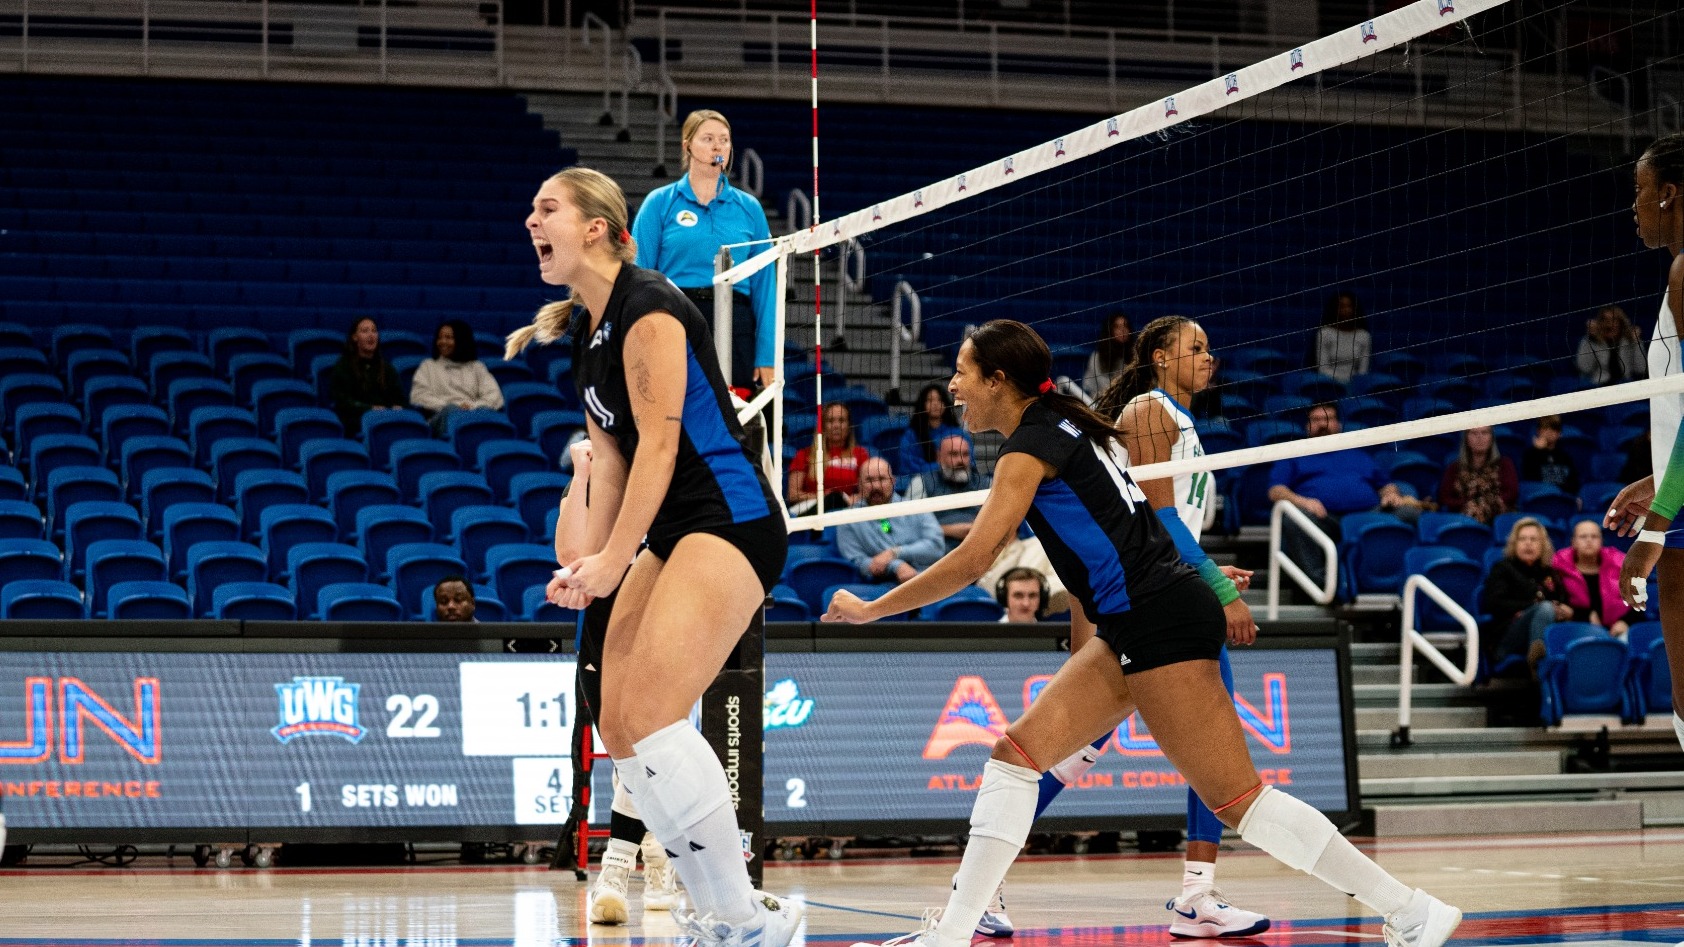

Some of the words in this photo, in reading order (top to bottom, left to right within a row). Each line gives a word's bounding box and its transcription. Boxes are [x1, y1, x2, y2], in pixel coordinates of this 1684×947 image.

[1186, 471, 1209, 509] 14
[282, 680, 355, 726] UWG
[386, 694, 441, 738] 22
[725, 696, 742, 747] sports
[0, 780, 162, 798] NFERENCE
[547, 768, 563, 793] 4
[786, 778, 808, 808] 2
[296, 782, 312, 812] 1
[342, 784, 399, 808] SETS
[404, 784, 459, 808] WON
